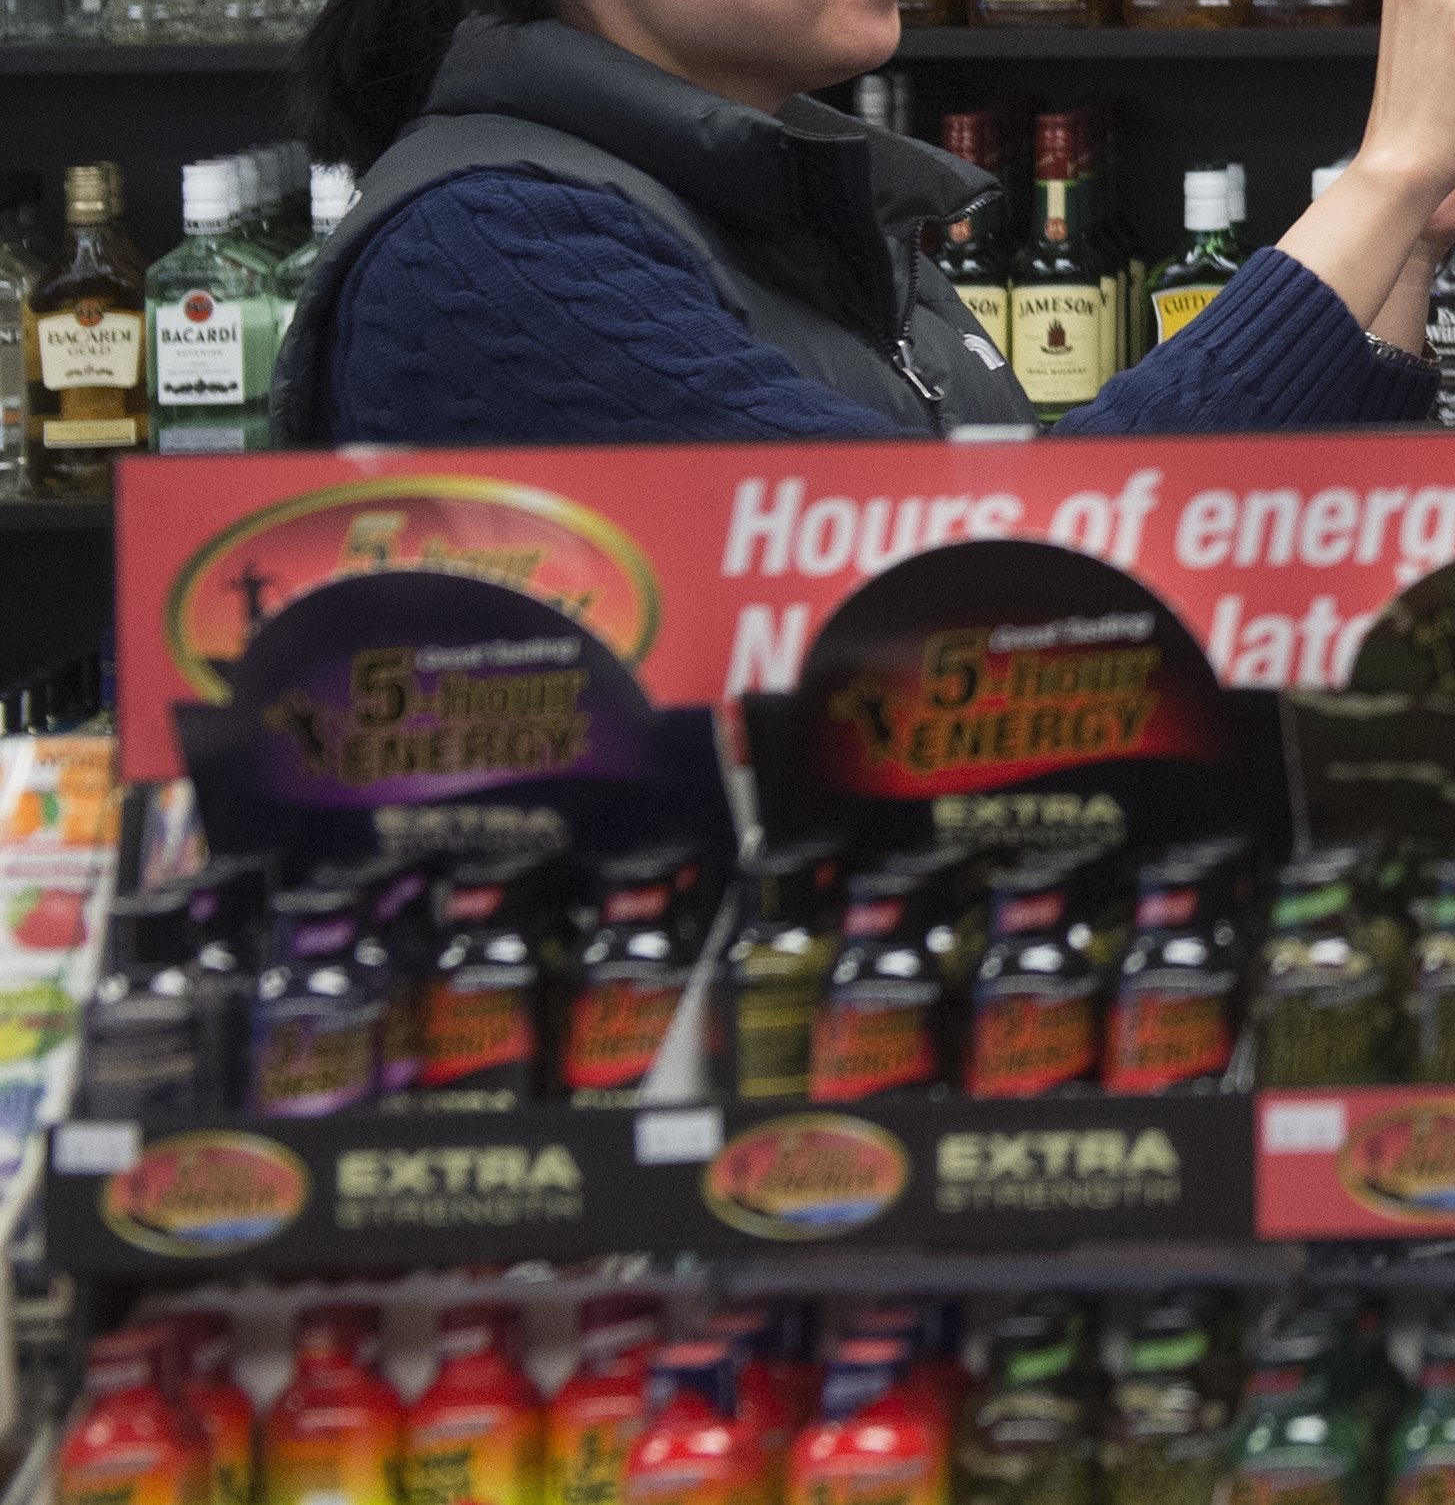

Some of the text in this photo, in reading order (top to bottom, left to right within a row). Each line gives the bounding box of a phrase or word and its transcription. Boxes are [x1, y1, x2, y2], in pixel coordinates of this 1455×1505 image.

[160, 322, 238, 344] BACARDÍ
[1017, 296, 1094, 318] JAMESON
[722, 475, 1020, 578] Hours
[1050, 468, 1163, 567] of
[724, 602, 808, 699] N
[338, 710, 592, 785] ENERGY
[902, 693, 1160, 776] ENERGY
[931, 792, 1125, 827] EXTRA
[334, 1144, 584, 1199] EXTRA
[934, 1128, 1182, 1182] EXTRA
